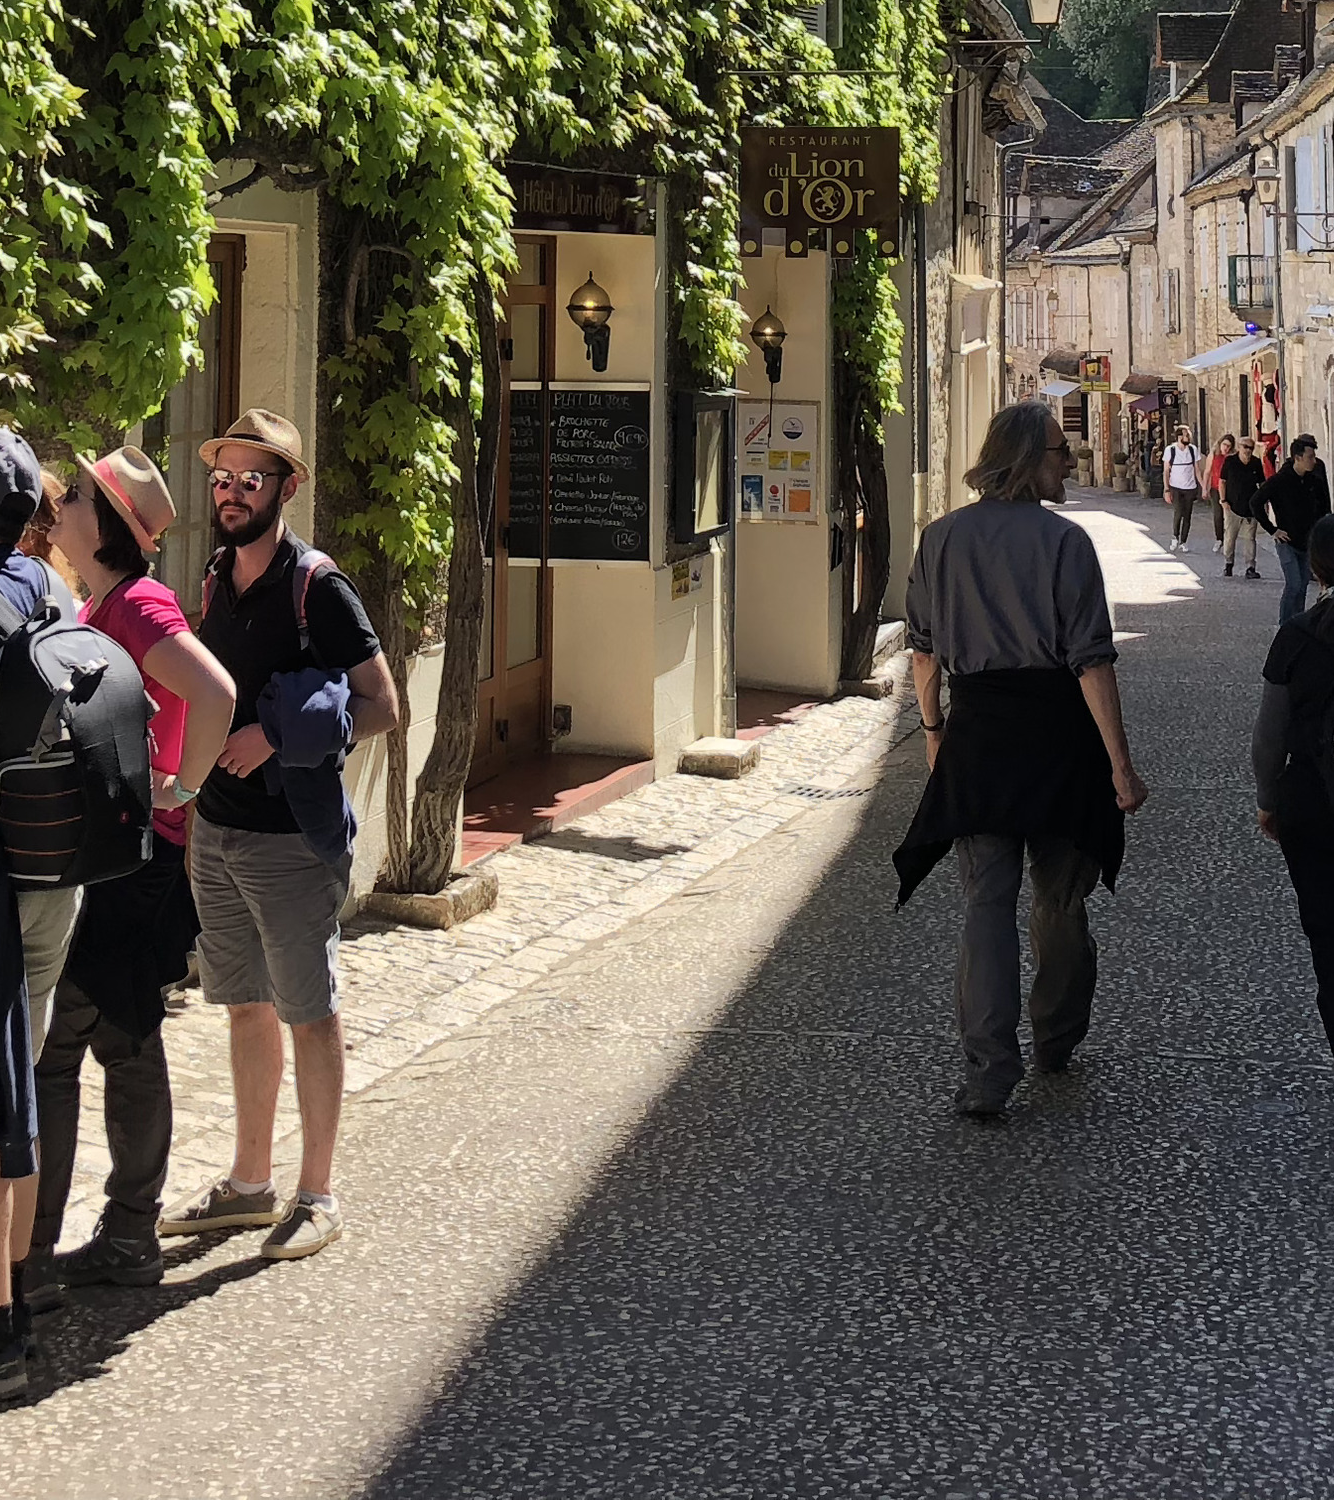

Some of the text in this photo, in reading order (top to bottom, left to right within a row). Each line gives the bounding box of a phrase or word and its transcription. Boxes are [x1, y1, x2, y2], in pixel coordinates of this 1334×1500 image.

[768, 136, 872, 146] RESTAURANT
[768, 152, 865, 178] du Lion
[523, 180, 555, 213] Hôtel
[570, 184, 594, 216] Lion
[594, 185, 619, 221] d'Or
[763, 177, 876, 224] d'Or
[589, 393, 602, 406] DU
